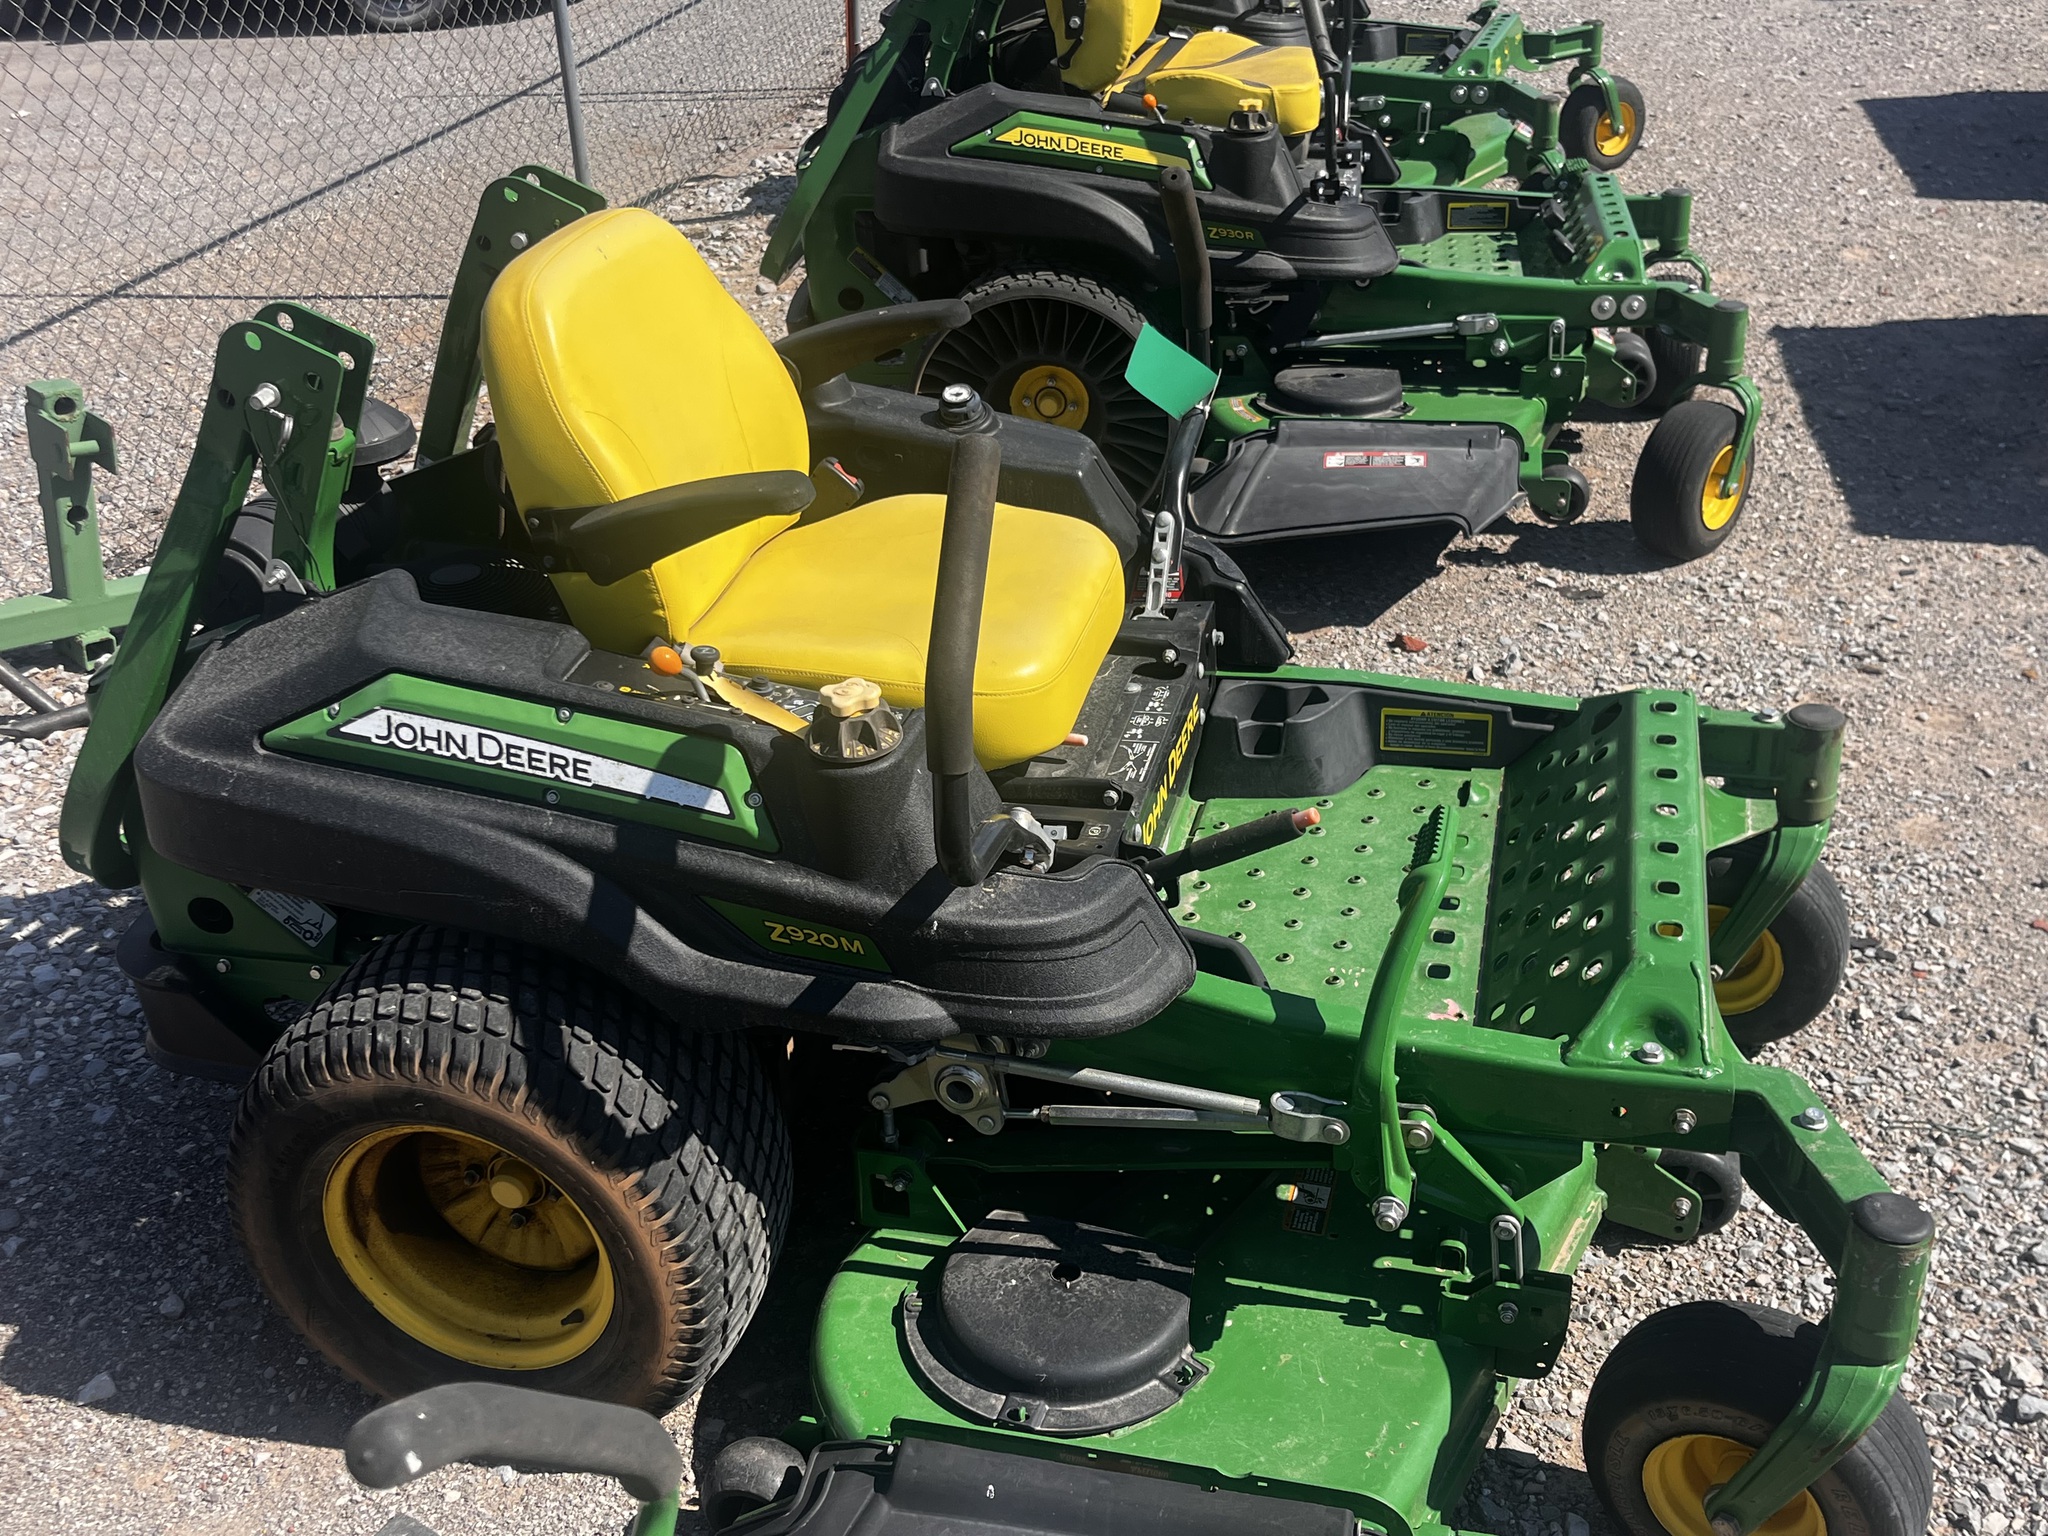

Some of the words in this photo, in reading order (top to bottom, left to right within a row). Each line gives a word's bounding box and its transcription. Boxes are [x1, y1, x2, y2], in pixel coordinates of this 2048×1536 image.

[1013, 130, 1062, 150] JOHN
[1066, 137, 1124, 159] DEERE
[1206, 227, 1255, 241] Z930R
[374, 714, 468, 758] JOHN
[477, 732, 593, 783] DEERE
[1142, 775, 1168, 846] JOHN
[1167, 692, 1200, 789] DEERE
[763, 920, 865, 955] Z920M
